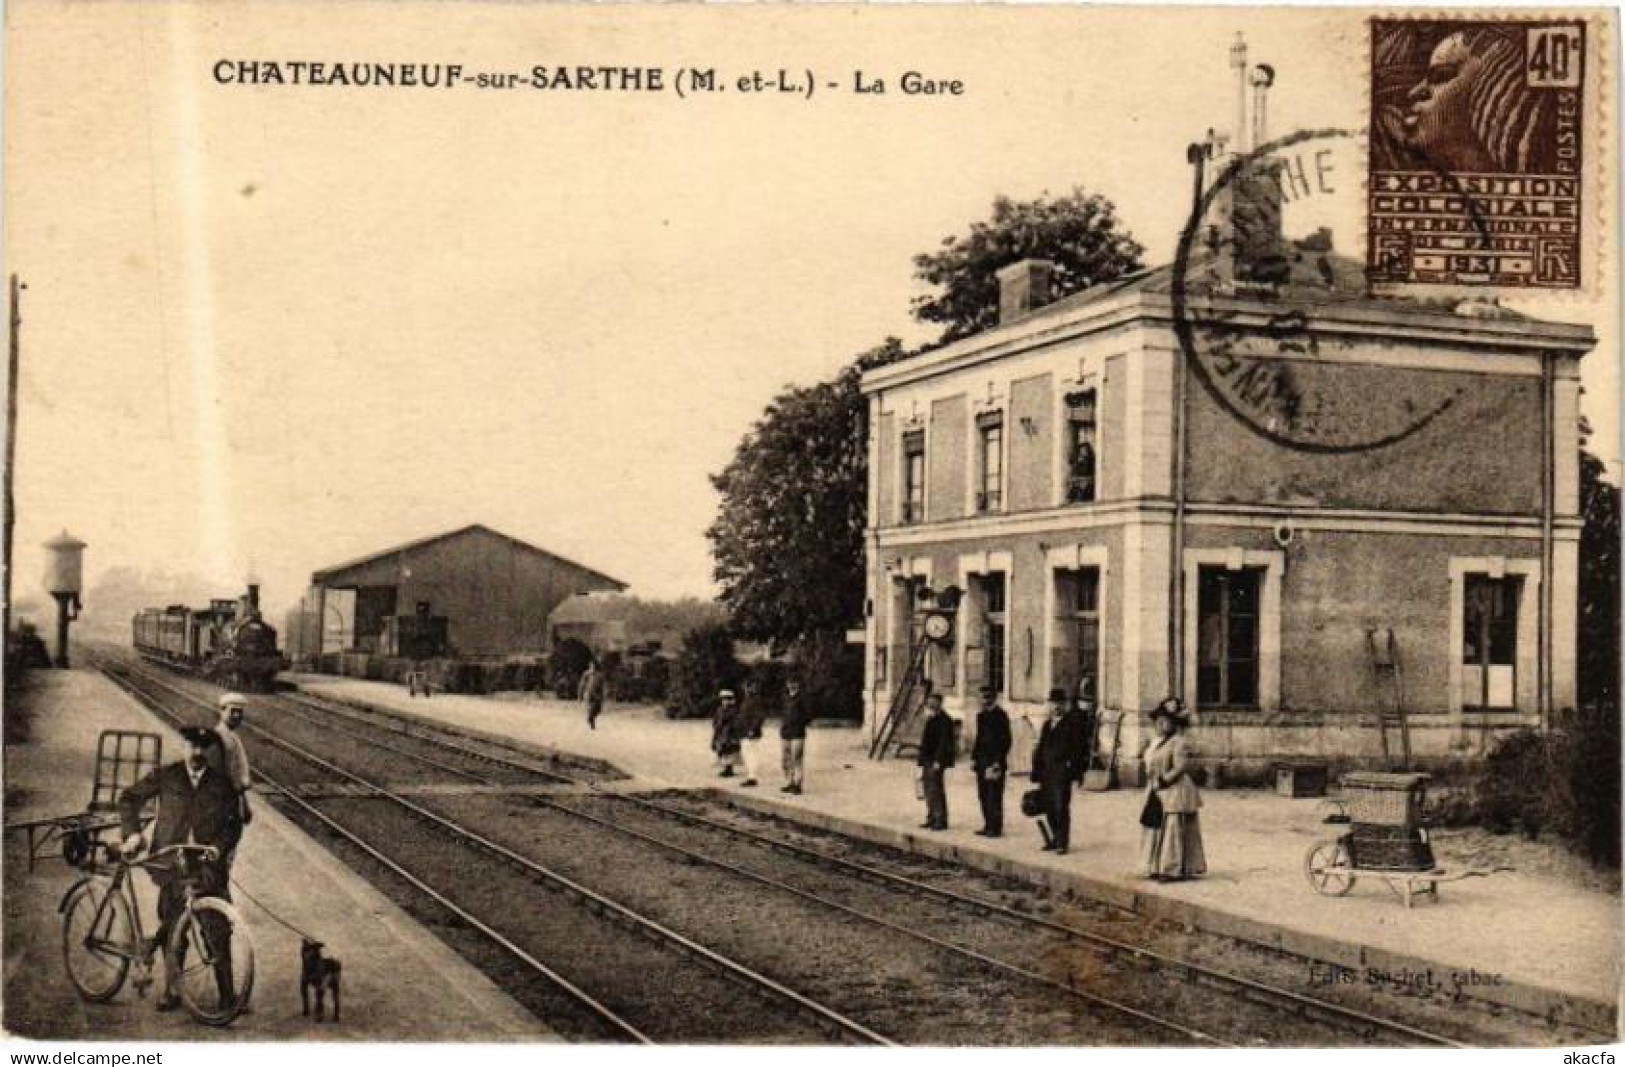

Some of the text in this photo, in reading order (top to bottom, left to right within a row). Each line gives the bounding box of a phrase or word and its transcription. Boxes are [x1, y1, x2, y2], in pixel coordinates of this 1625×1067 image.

[675, 67, 726, 98] (M.
[854, 70, 885, 94] La
[901, 71, 964, 95] Gare
[1557, 92, 1576, 173] POSTES
[1373, 175, 1574, 197] EXPOSITION
[1374, 197, 1575, 217] COLONIALE
